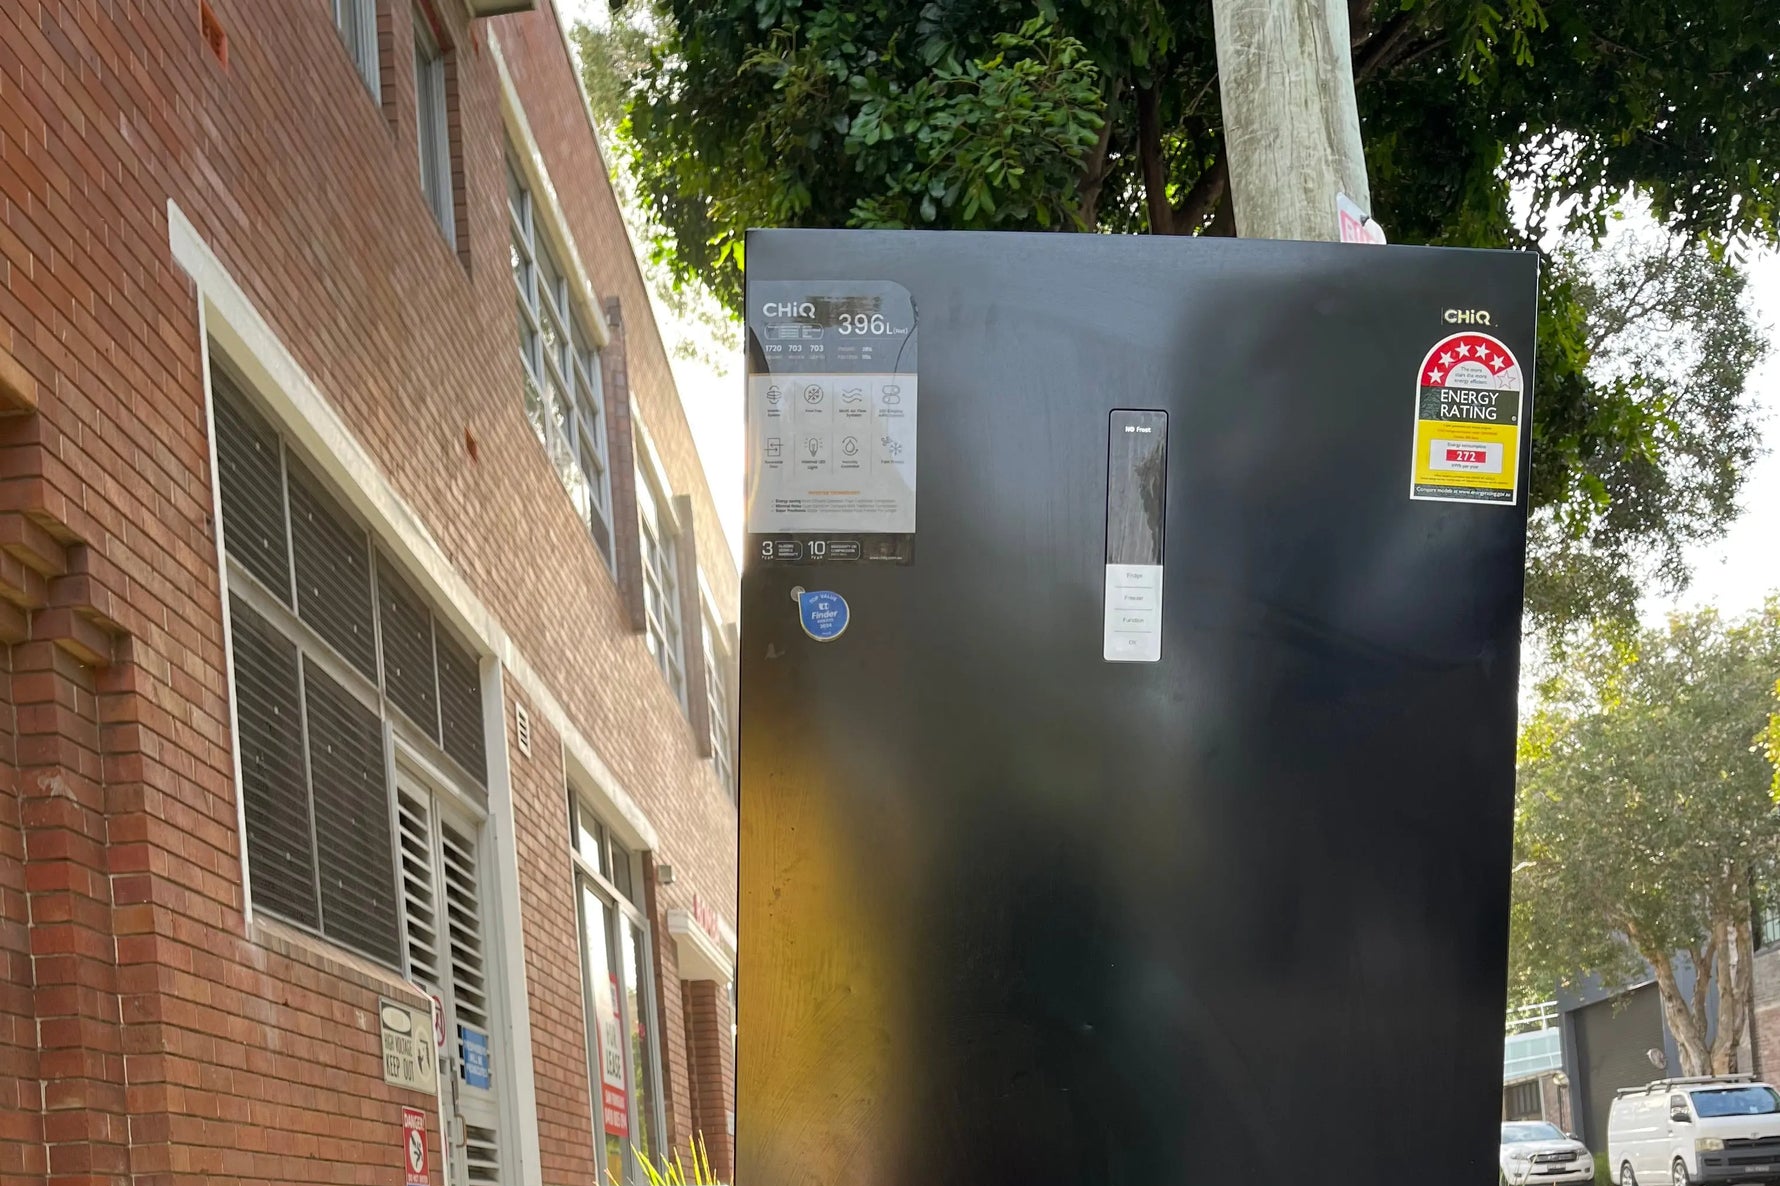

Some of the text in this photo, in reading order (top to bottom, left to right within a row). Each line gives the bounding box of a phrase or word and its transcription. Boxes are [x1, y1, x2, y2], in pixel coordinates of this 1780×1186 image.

[763, 302, 816, 318] CHiQ
[1444, 308, 1491, 326] CHiQ
[1440, 389, 1499, 405] ENERGY
[1440, 403, 1497, 420] RATING
[1456, 451, 1476, 461] 272
[762, 541, 773, 556] 3
[808, 541, 826, 555] 10
[811, 610, 838, 620] Finder
[386, 1053, 414, 1082] KEEP OUT
[606, 1053, 621, 1080] LEASE
